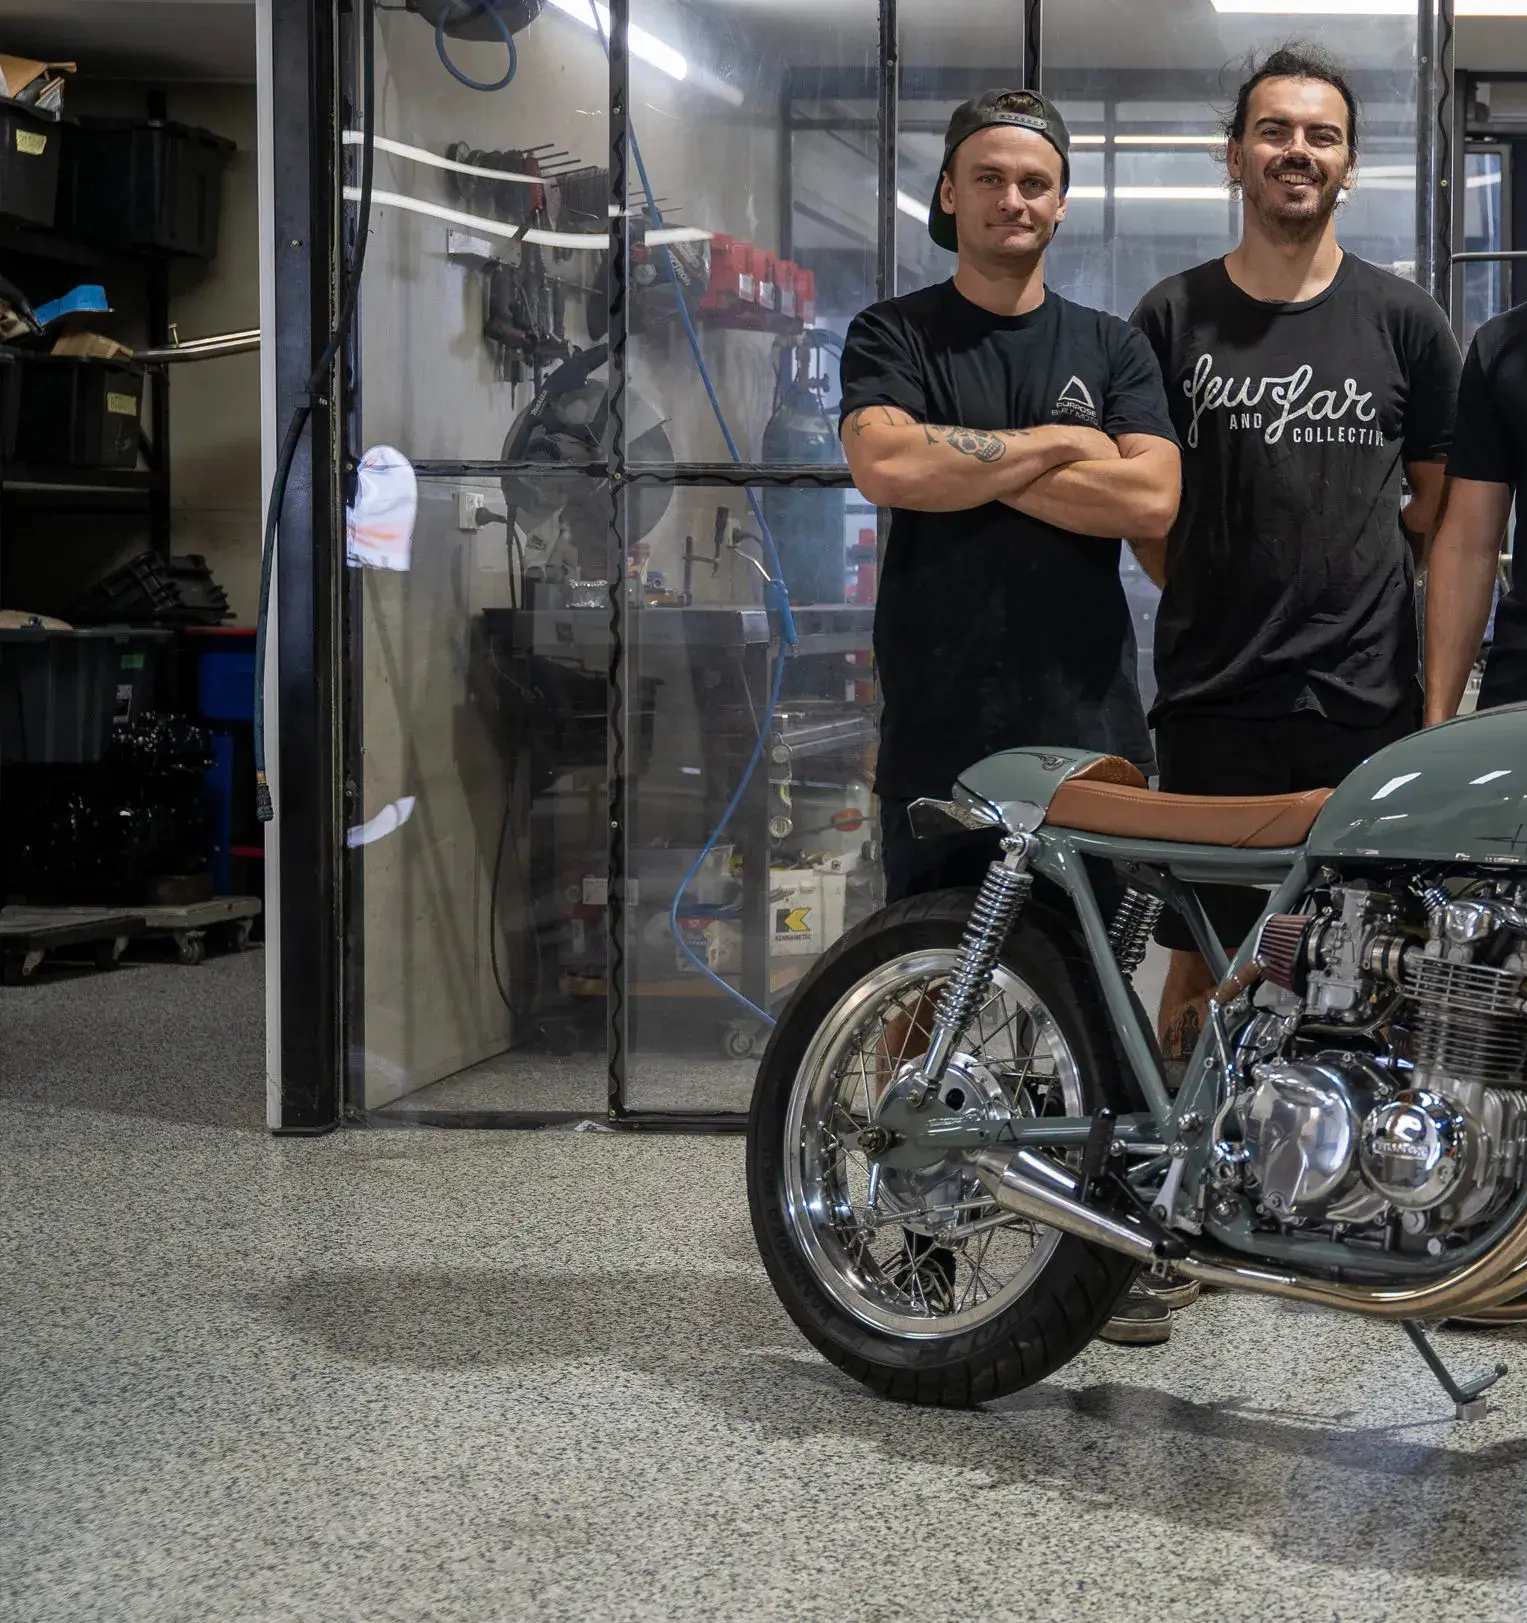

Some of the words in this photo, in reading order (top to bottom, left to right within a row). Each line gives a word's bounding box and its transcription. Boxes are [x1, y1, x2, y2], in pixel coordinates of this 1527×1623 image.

[1056, 401, 1097, 417] PURPOSE
[1075, 411, 1099, 426] MOTO
[1229, 413, 1263, 430] AND
